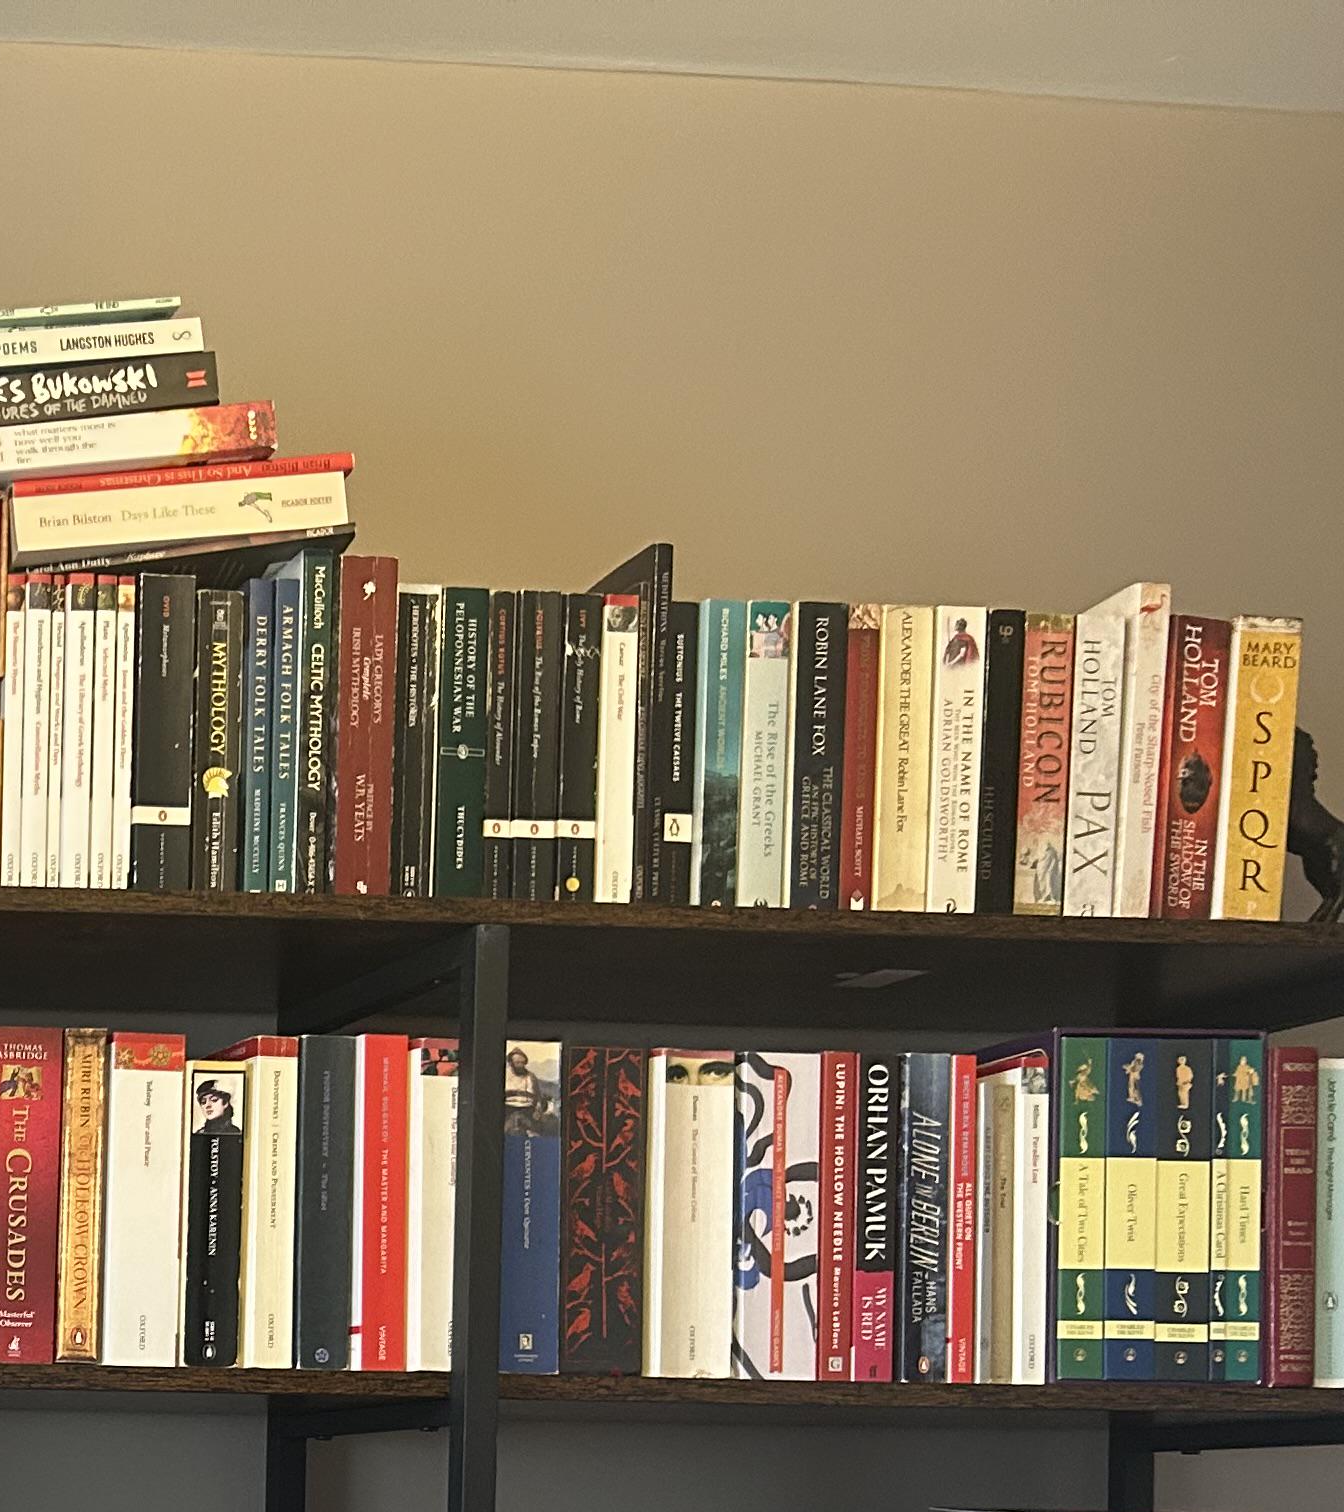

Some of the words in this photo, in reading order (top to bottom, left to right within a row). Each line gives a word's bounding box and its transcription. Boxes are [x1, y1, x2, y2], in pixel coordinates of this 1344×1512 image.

[59, 336, 112, 351] LANGSTON
[115, 332, 155, 346] HUGHES
[32, 364, 158, 404] BUKOWSKI
[44, 404, 61, 417] OF
[66, 399, 86, 413] THE
[90, 391, 147, 409] DAMNED
[39, 511, 69, 528] Brian
[72, 508, 112, 524] Bilston
[121, 506, 149, 522] Days
[152, 505, 177, 518] Like
[181, 502, 215, 516] These
[309, 643, 324, 691] CELTIC
[1241, 655, 1296, 670] BEARD
[1247, 641, 1294, 656] MARY
[1177, 624, 1203, 742] HOLLAND
[1201, 658, 1220, 707] TOM
[307, 693, 323, 792] MYTHOLOGY
[1033, 640, 1068, 806] RUBICON
[11, 1105, 30, 1141] THE
[865, 1064, 889, 1160] ORHAN
[1179, 1173, 1188, 1199] Great
[5, 1149, 32, 1302] CRUSADES
[864, 1168, 888, 1260] PAMUK
[1177, 1202, 1188, 1263] Expectations
